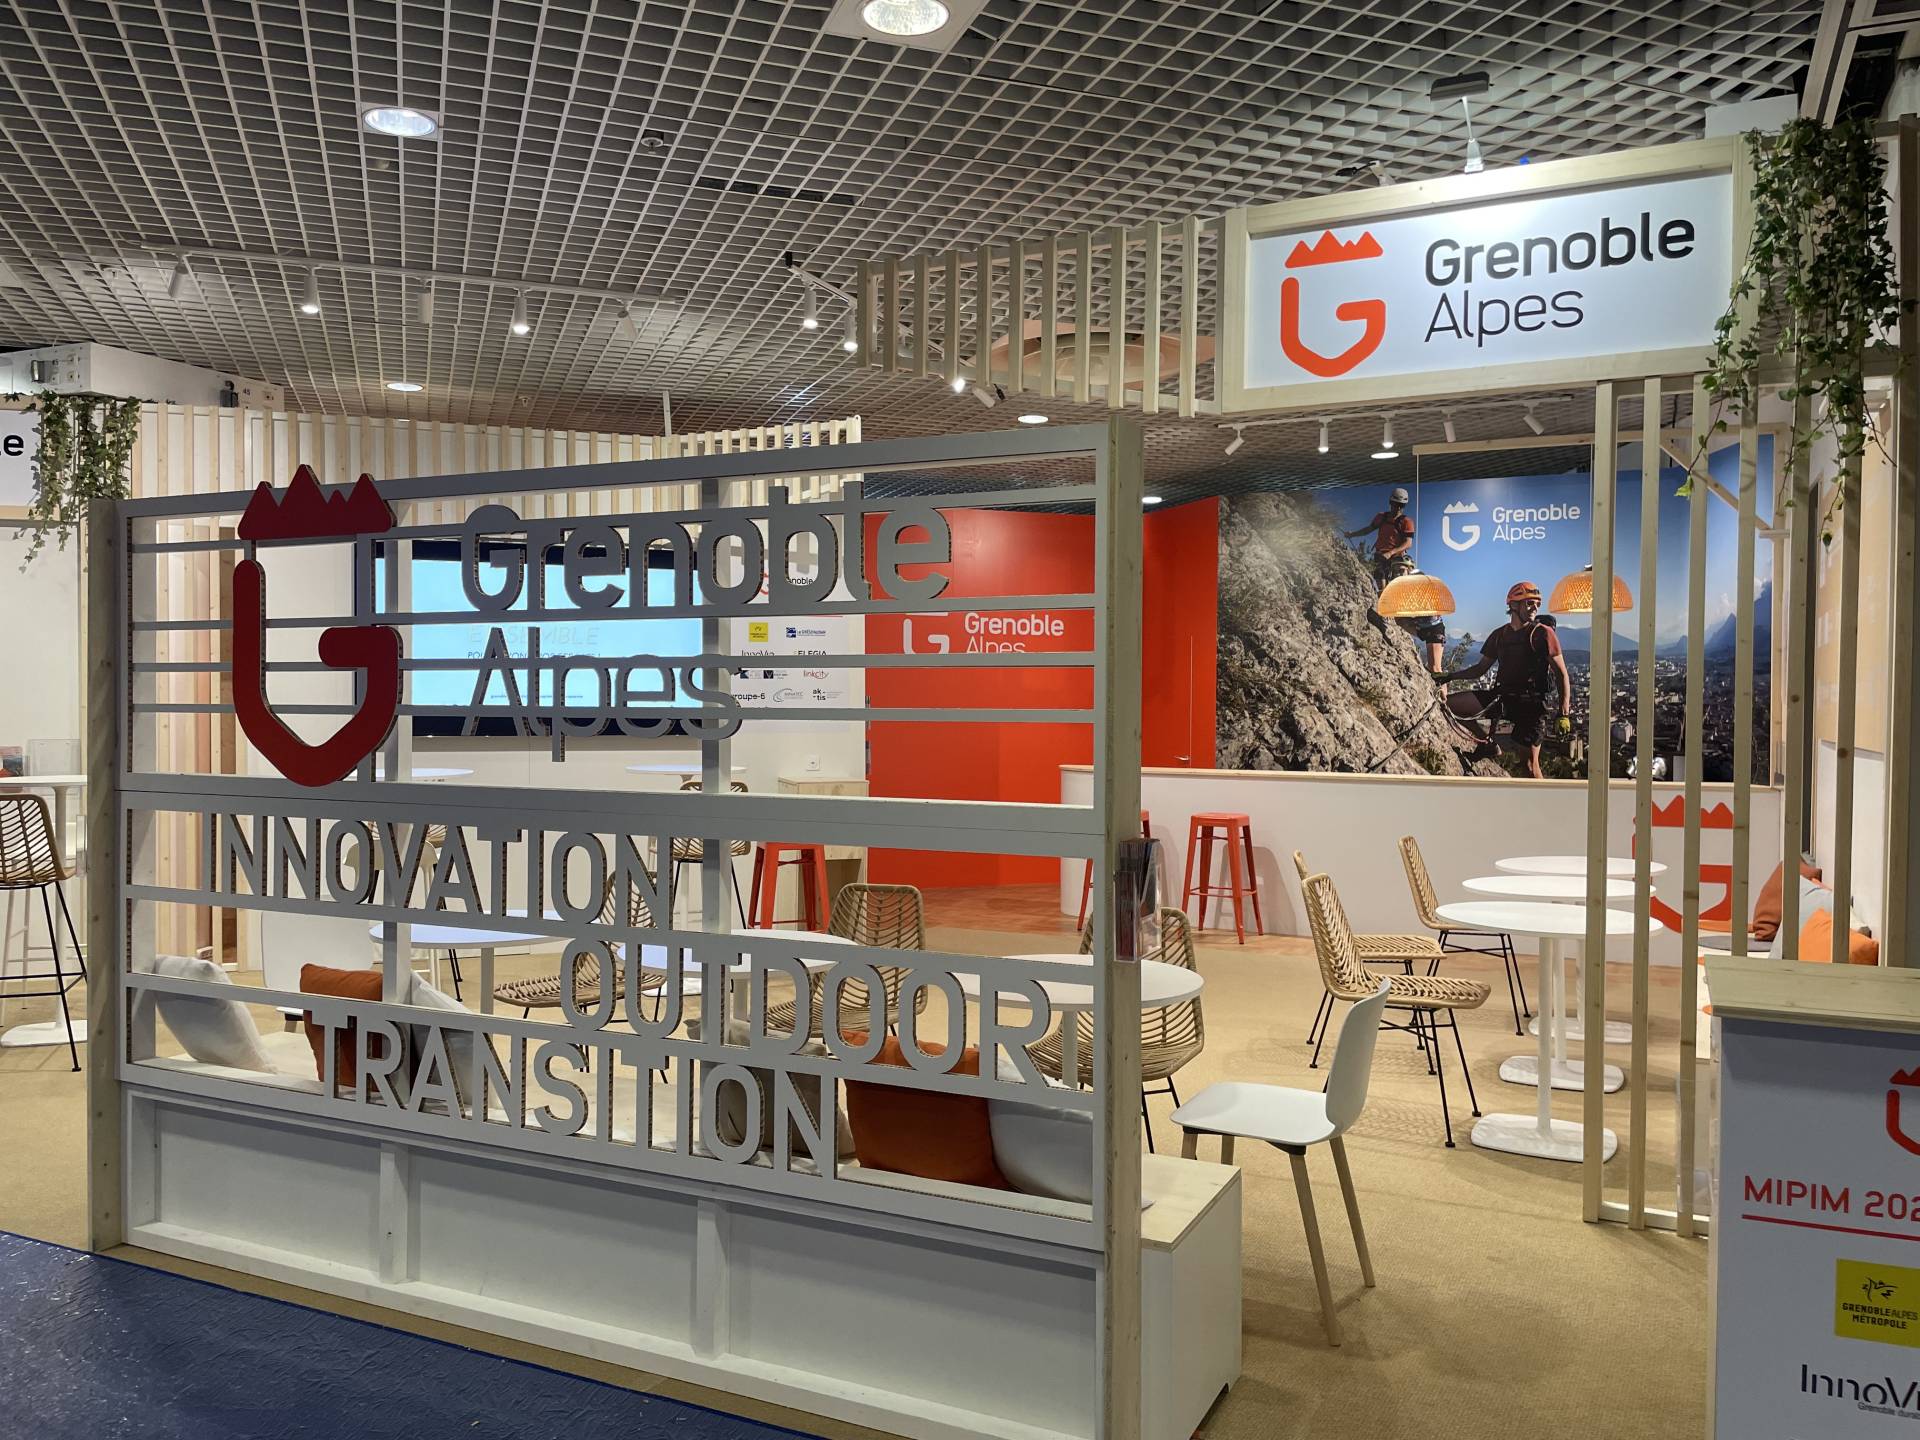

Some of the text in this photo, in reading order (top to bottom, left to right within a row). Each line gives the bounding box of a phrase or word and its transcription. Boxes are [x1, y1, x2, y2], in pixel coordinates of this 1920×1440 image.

[1425, 211, 1695, 287] Grenoble
[1424, 291, 1584, 348] Alpes
[461, 481, 952, 612] Grenoble
[1492, 503, 1581, 524] Grenoble
[1492, 525, 1546, 544] Alpes
[964, 611, 1065, 637] Grenoble
[462, 626, 742, 763] Alpes
[202, 812, 674, 931] INNOVATION
[560, 935, 1052, 1089] OUTDOOR
[310, 1008, 840, 1181] TRANSITION
[1744, 1175, 1851, 1214] MIPIM
